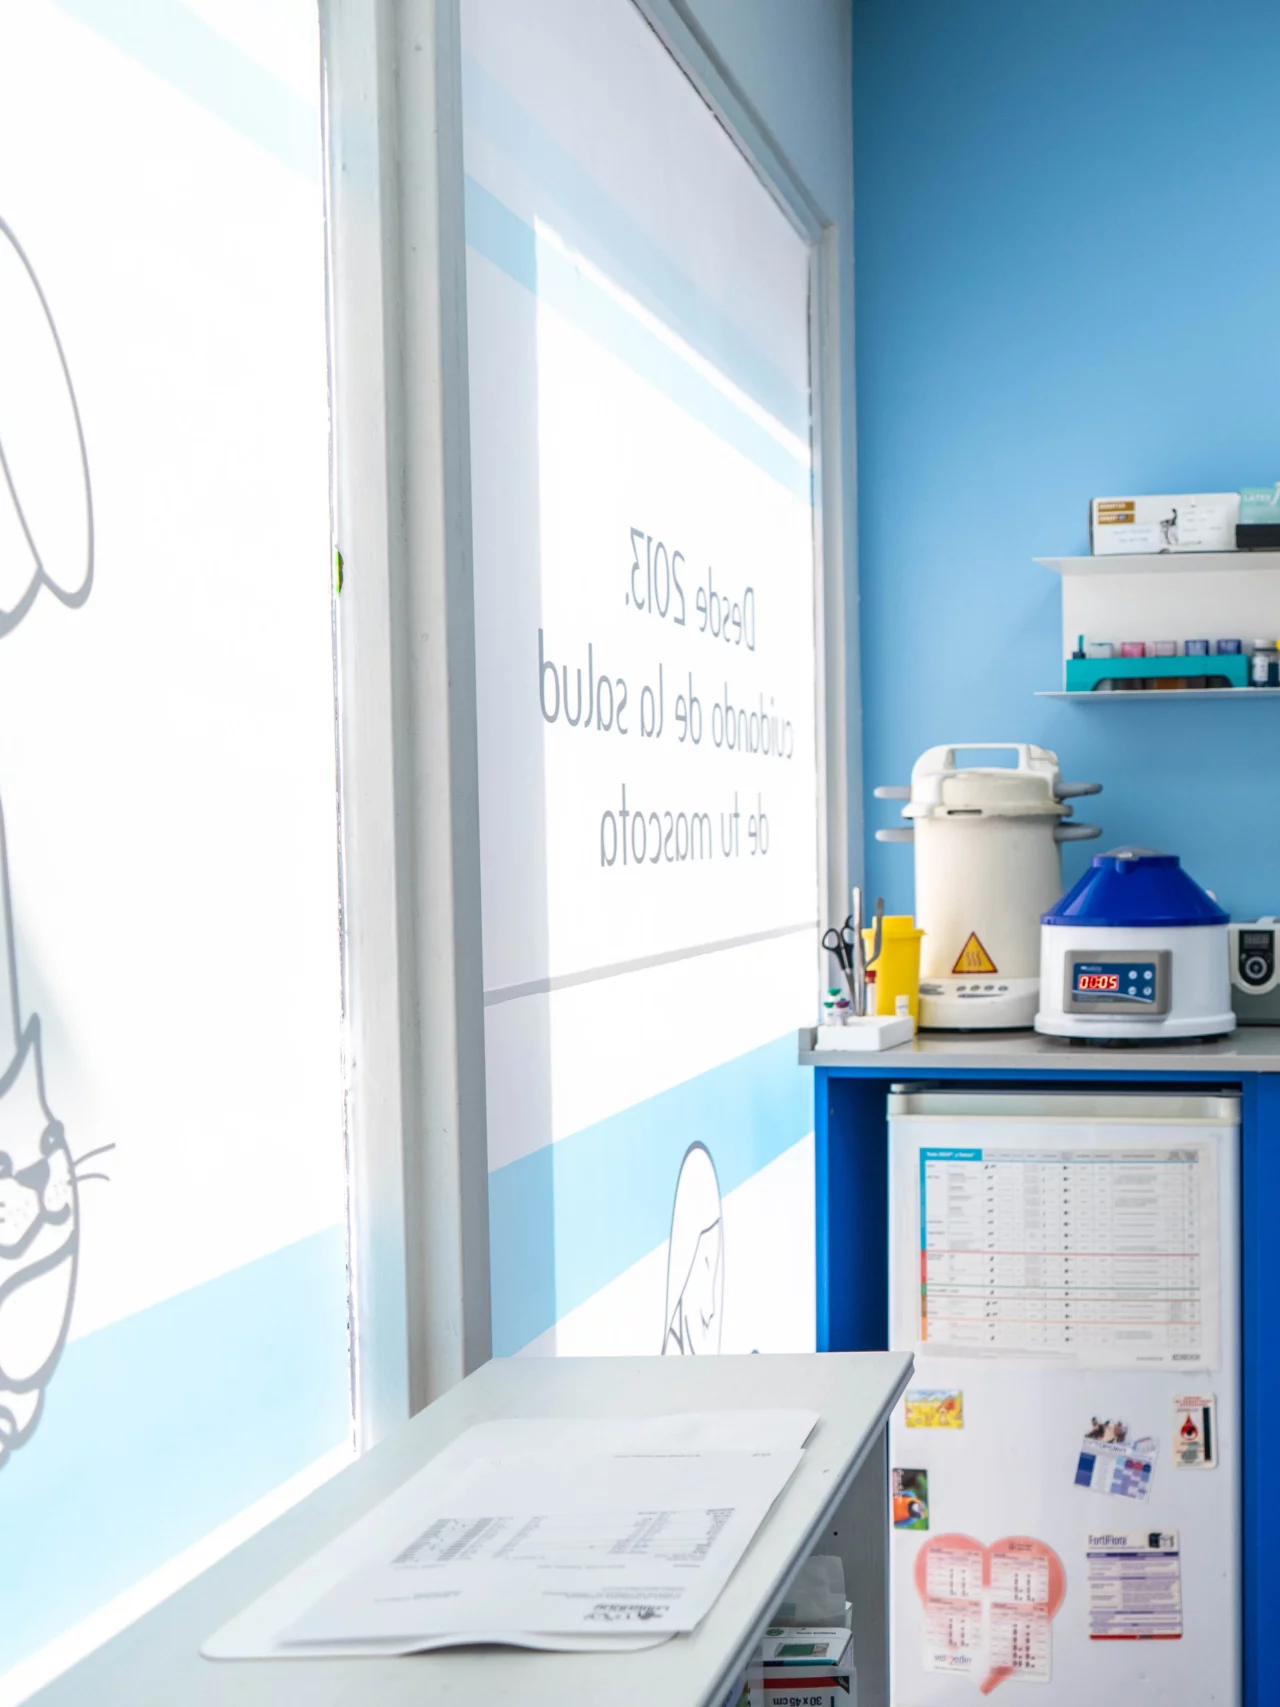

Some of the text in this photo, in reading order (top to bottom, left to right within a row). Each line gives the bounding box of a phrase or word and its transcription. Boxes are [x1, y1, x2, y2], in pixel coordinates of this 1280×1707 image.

[1079, 975, 1118, 990] 00:05
[772, 1697, 788, 1705] cm
[789, 1696, 801, 1706] 45
[810, 1697, 823, 1706] 30
